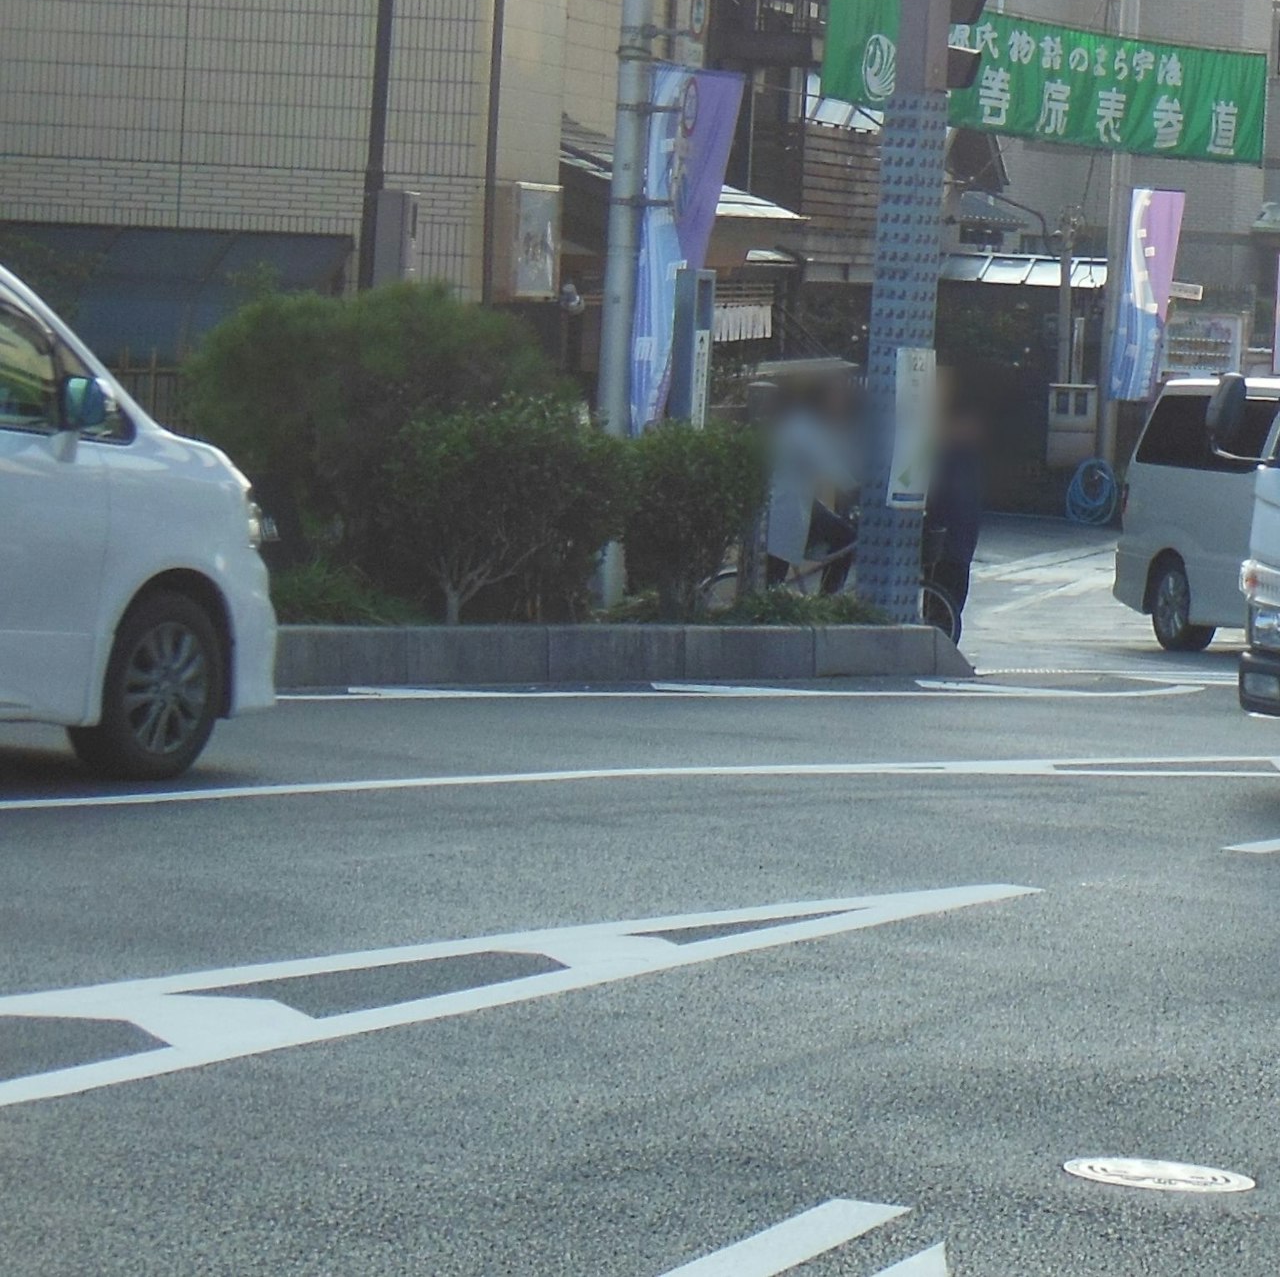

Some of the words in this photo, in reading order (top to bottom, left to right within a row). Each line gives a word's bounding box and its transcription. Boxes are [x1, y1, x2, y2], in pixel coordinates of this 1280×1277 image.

[946, 64, 1239, 156] 等院表参道
